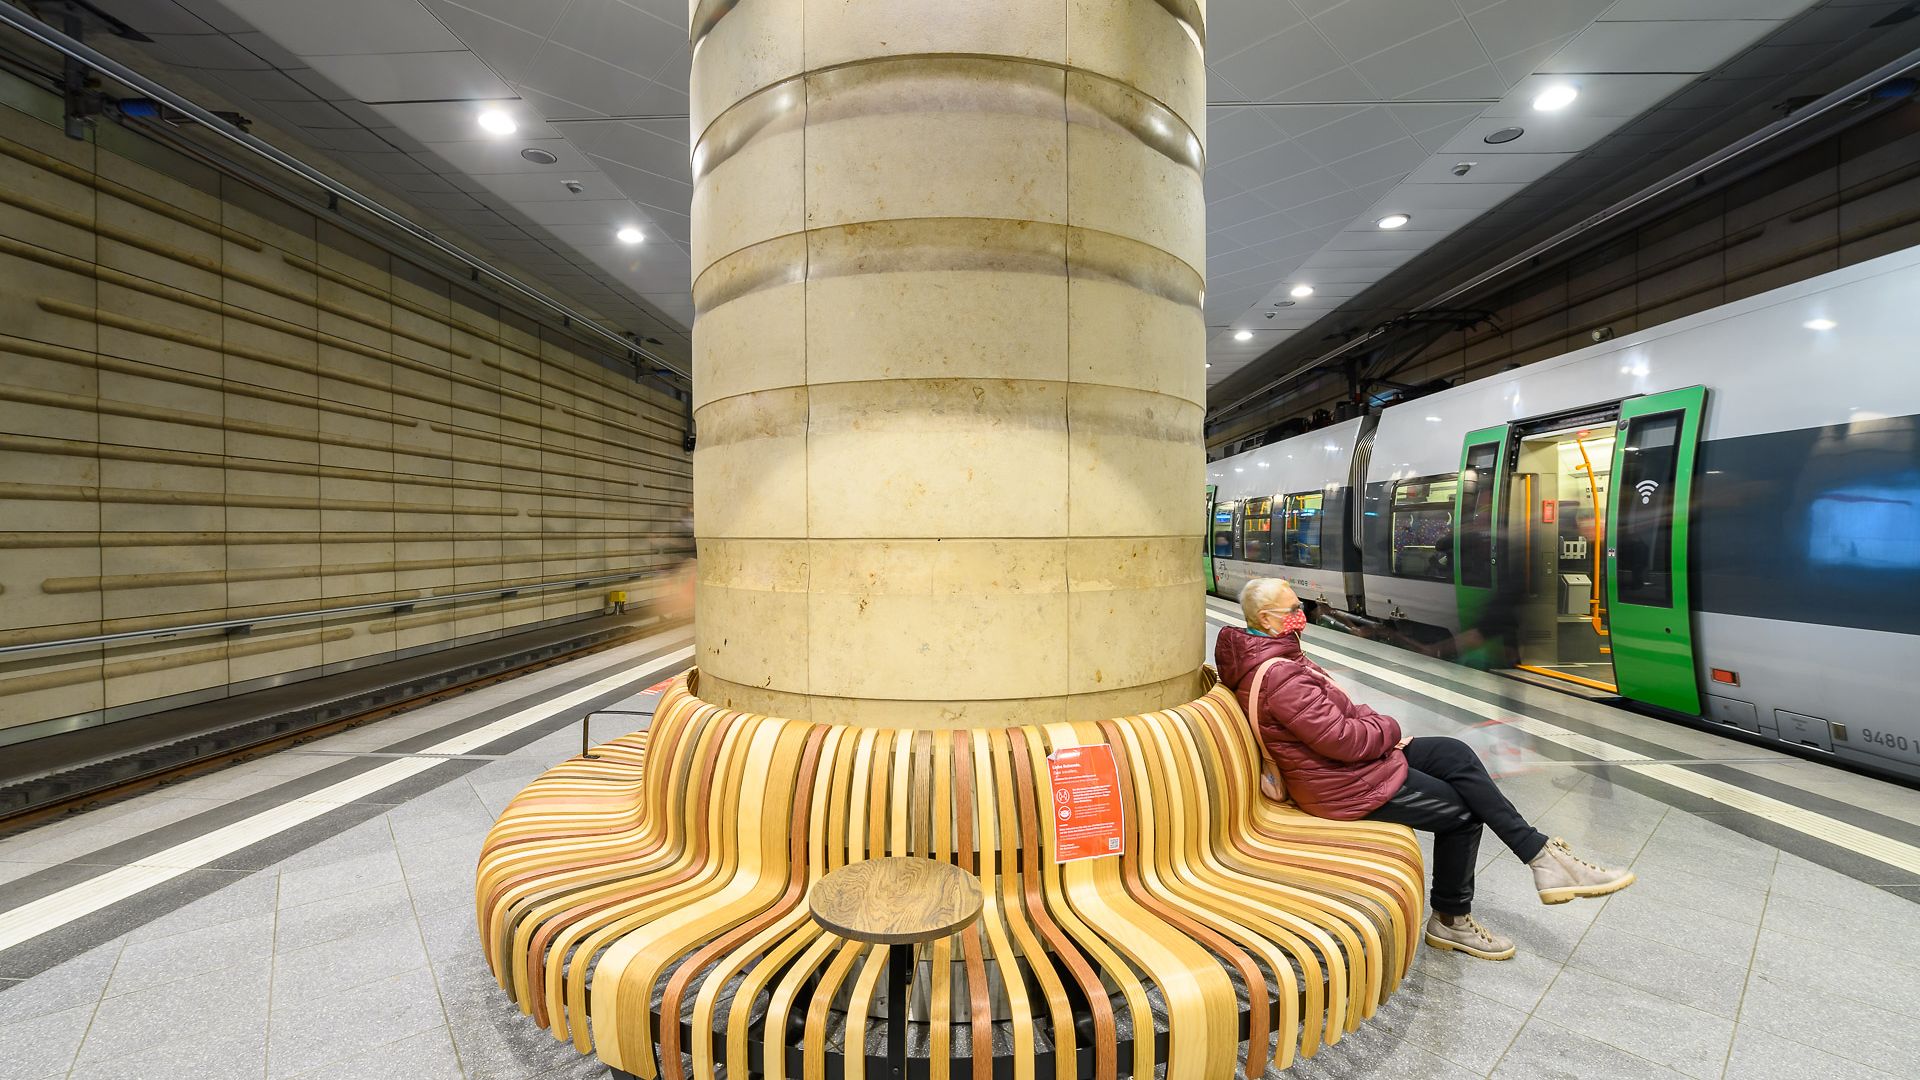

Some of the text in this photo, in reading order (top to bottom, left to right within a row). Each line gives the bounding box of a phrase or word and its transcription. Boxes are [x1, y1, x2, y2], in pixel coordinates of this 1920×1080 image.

[1235, 513, 1241, 527] 2
[1862, 728, 1920, 754] 9480 1
